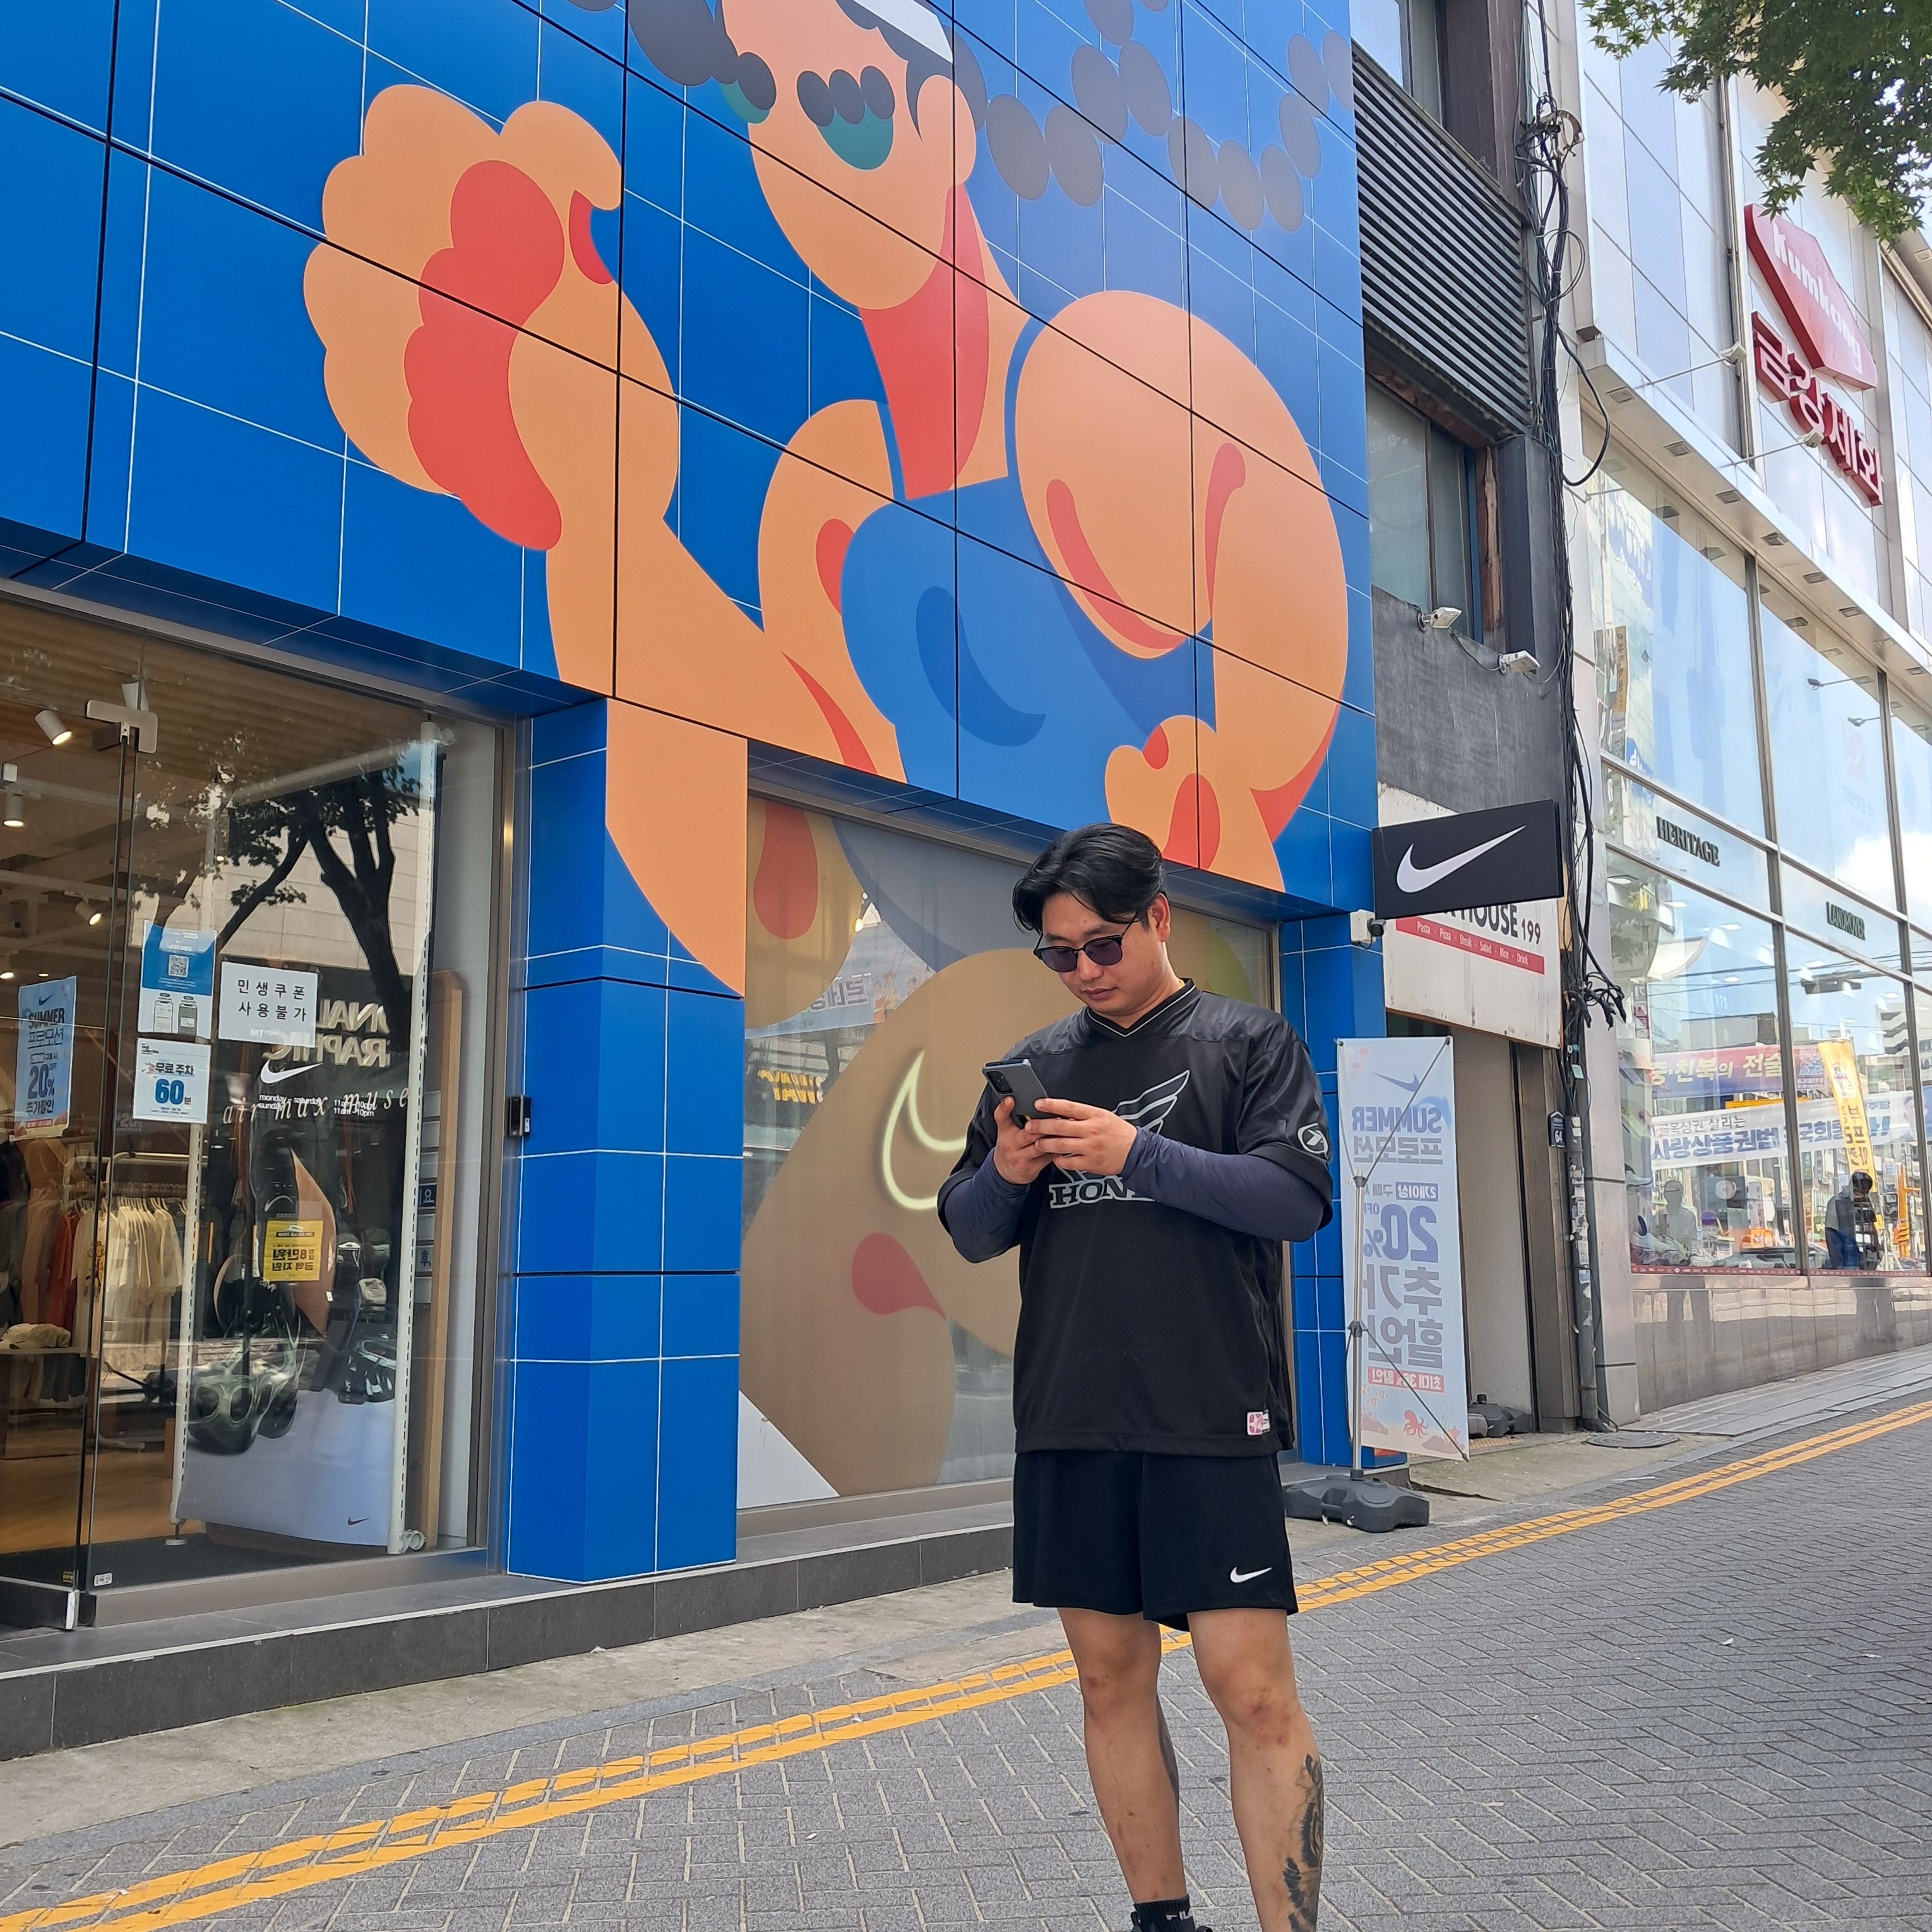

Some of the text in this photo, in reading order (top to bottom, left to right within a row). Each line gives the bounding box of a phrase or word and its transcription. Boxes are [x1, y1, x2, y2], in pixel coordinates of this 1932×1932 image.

[1753, 312, 1883, 506] 금강제화
[1655, 816, 1721, 868] HERITAGE
[1521, 918, 1541, 945] 199
[1825, 901, 1866, 941] LANDROVER
[1416, 920, 1529, 966] Pasta Pizza Steak Salad Rice Drink
[28, 1008, 65, 1029] SUMMER
[27, 1027, 64, 1049] 프로모션
[28, 1063, 55, 1099] 20%
[155, 1062, 194, 1076] 무료 주차
[259, 1094, 286, 1104] monday
[1554, 1130, 1563, 1143] 64
[1659, 1116, 1746, 1136] 골목상권 살리는
